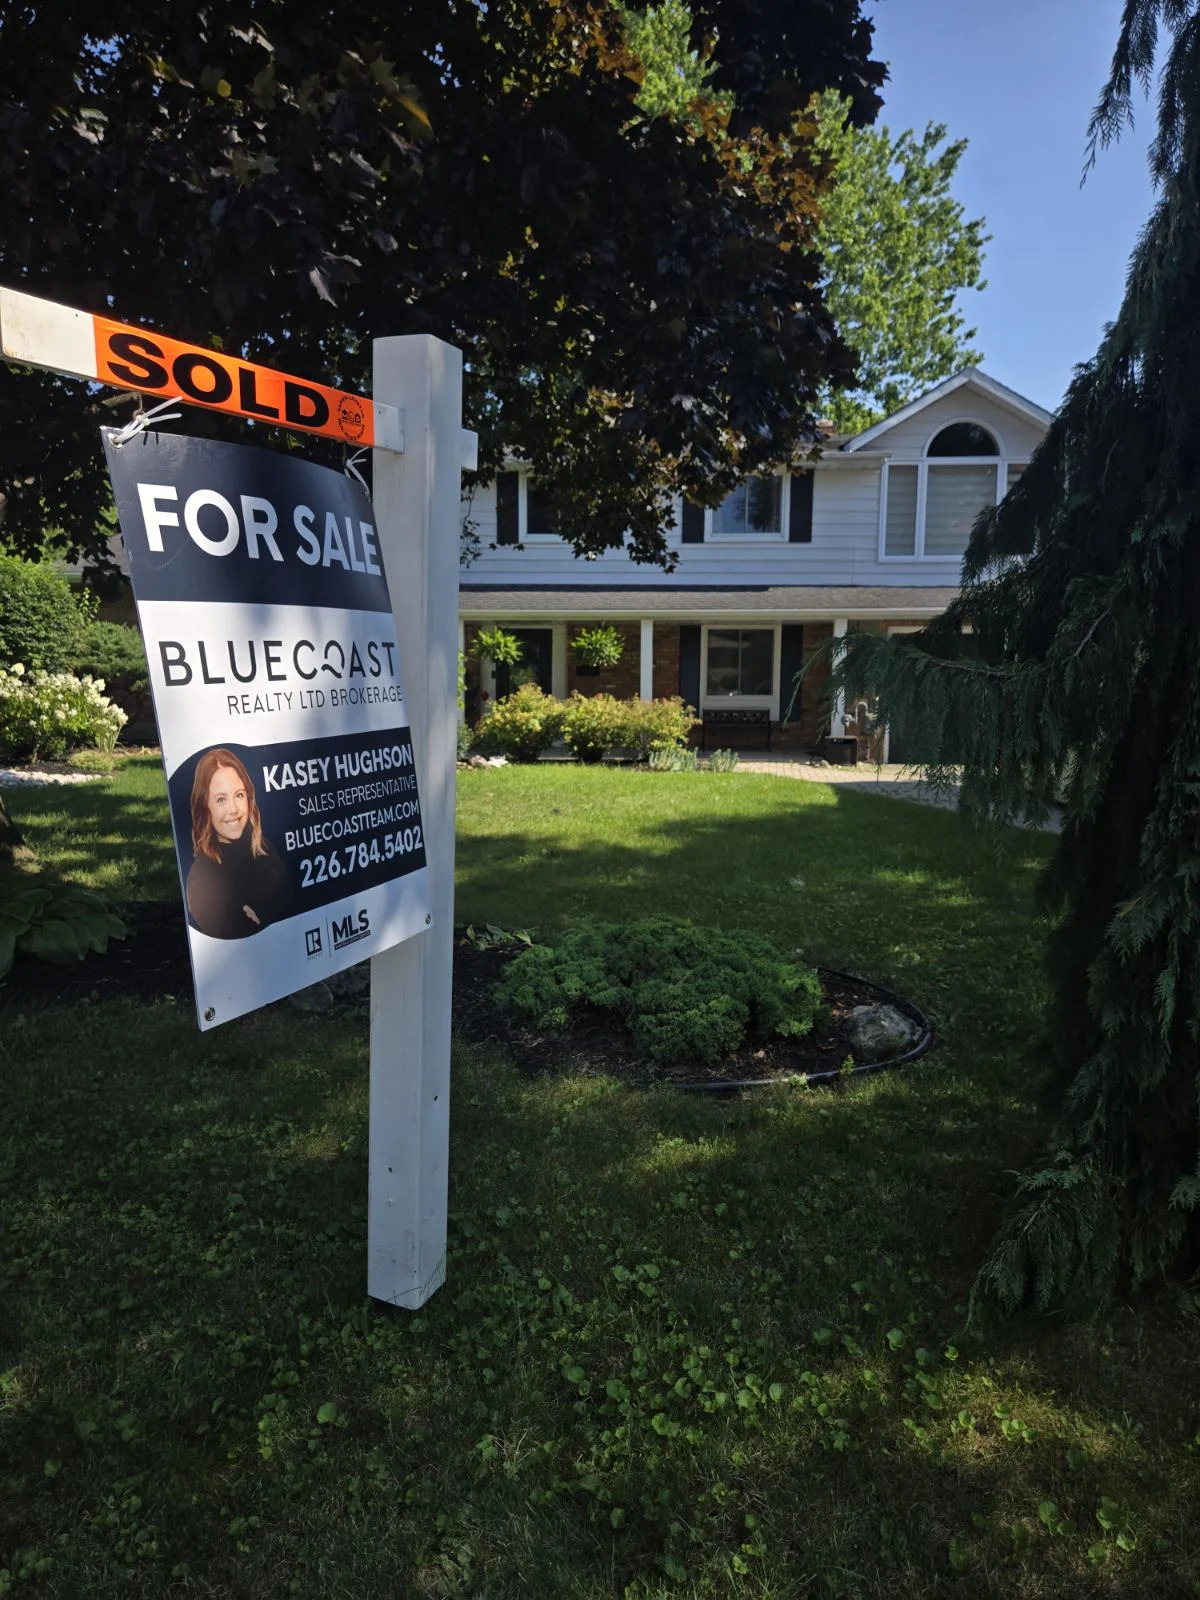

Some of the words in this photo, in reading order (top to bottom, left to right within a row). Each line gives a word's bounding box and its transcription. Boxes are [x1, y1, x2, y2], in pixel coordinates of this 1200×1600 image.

[106, 332, 330, 427] SOLD
[136, 482, 284, 562] FOR
[293, 504, 382, 576] SALE
[158, 639, 397, 687] BLUECOAST
[227, 691, 294, 715] REALTY
[299, 689, 326, 710] LTD
[330, 684, 403, 707] BROKERAGE
[262, 756, 331, 792] KASEY
[334, 743, 413, 779] HUGHSON
[298, 792, 335, 816] SALES
[337, 774, 417, 807] REPRESENTATIVE
[285, 799, 420, 851] BLUECOASTTEAM.COM
[299, 825, 423, 888] 226.784.5402
[331, 909, 370, 943] MLS
